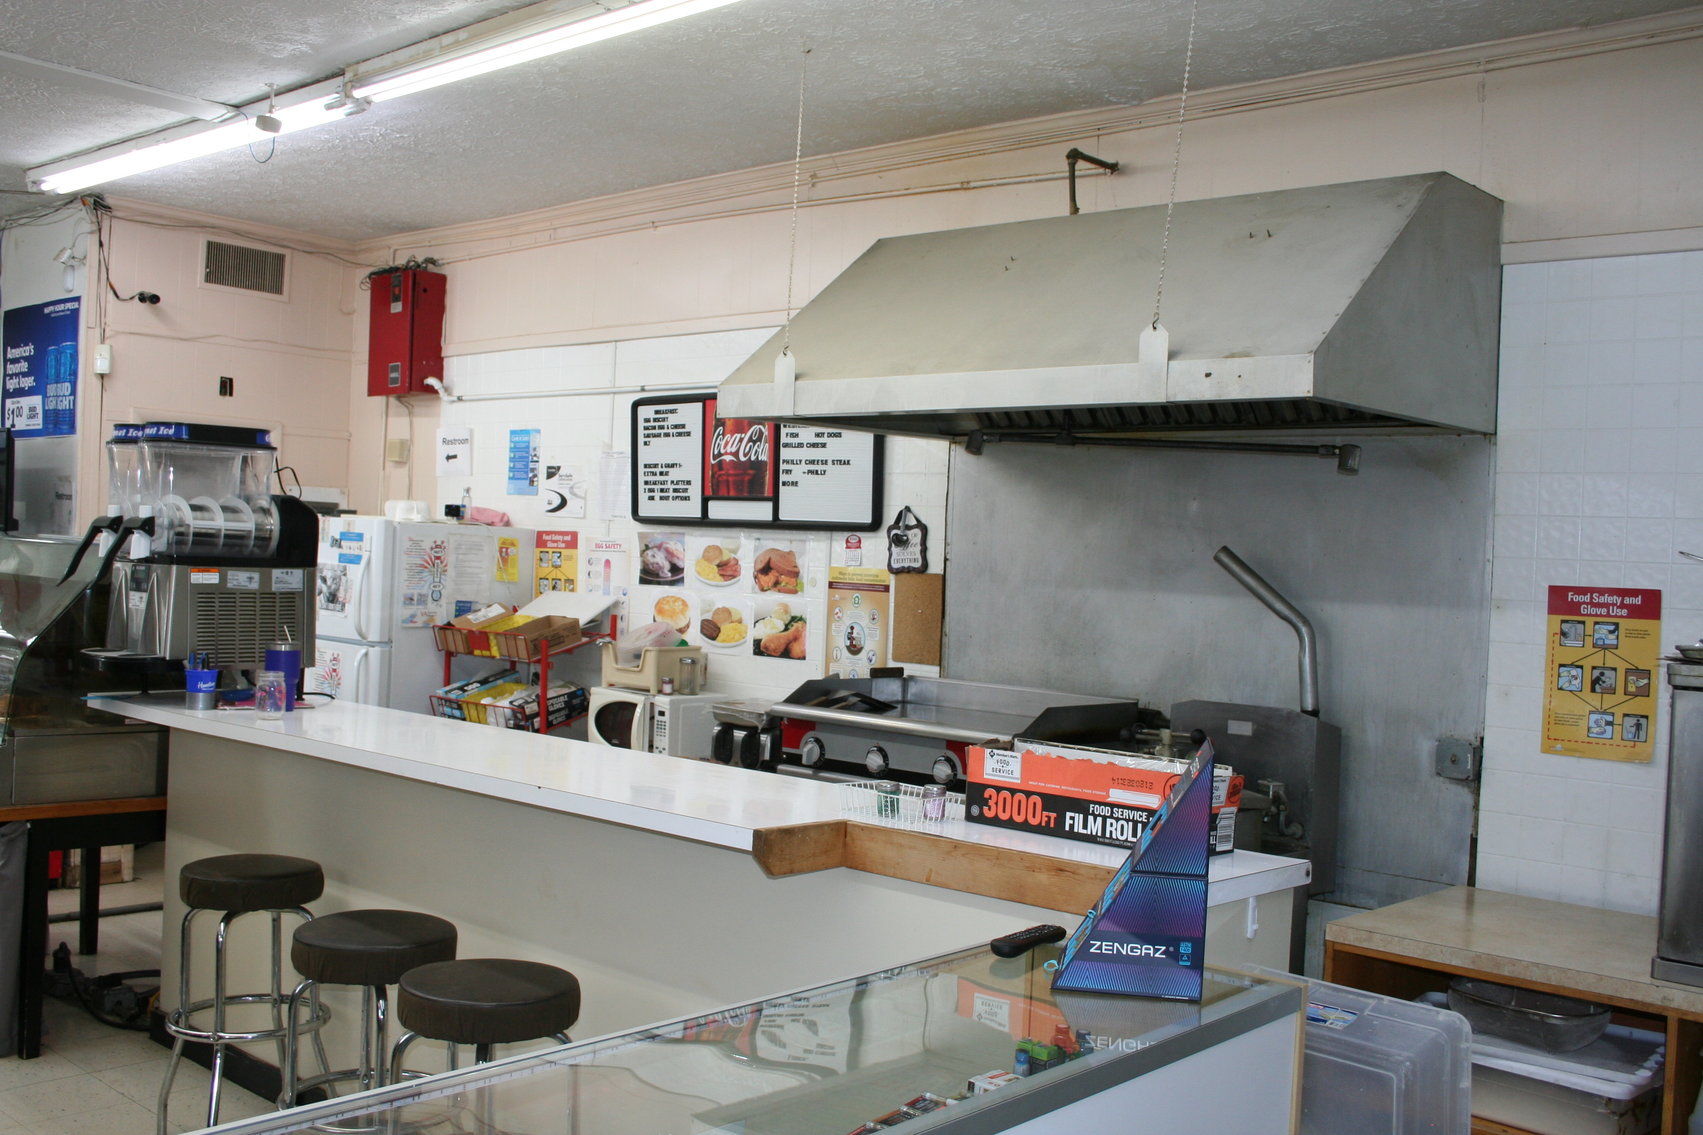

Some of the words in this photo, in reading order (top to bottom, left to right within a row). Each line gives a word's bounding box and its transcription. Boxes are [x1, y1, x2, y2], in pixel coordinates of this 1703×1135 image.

[7, 343, 35, 359] America's
[6, 360, 29, 375] favorite
[6, 375, 20, 392] light
[20, 375, 36, 390] lager.
[441, 436, 469, 447] Restroom
[710, 424, 769, 465] Coca-Cola
[893, 557, 919, 565] EVERYTHING
[1568, 592, 1590, 603] Food
[1592, 593, 1621, 606] Safety
[1623, 596, 1642, 605] and
[1580, 604, 1607, 615] Glove
[1609, 605, 1628, 616] Use
[991, 767, 1014, 776] SERVICE
[983, 788, 1042, 826] 3000
[1042, 811, 1057, 828] FT
[1090, 803, 1111, 816] FOOD
[1112, 807, 1148, 823] SERVICE
[1065, 811, 1103, 837] FILM
[1089, 940, 1167, 958] ZENGAZ
